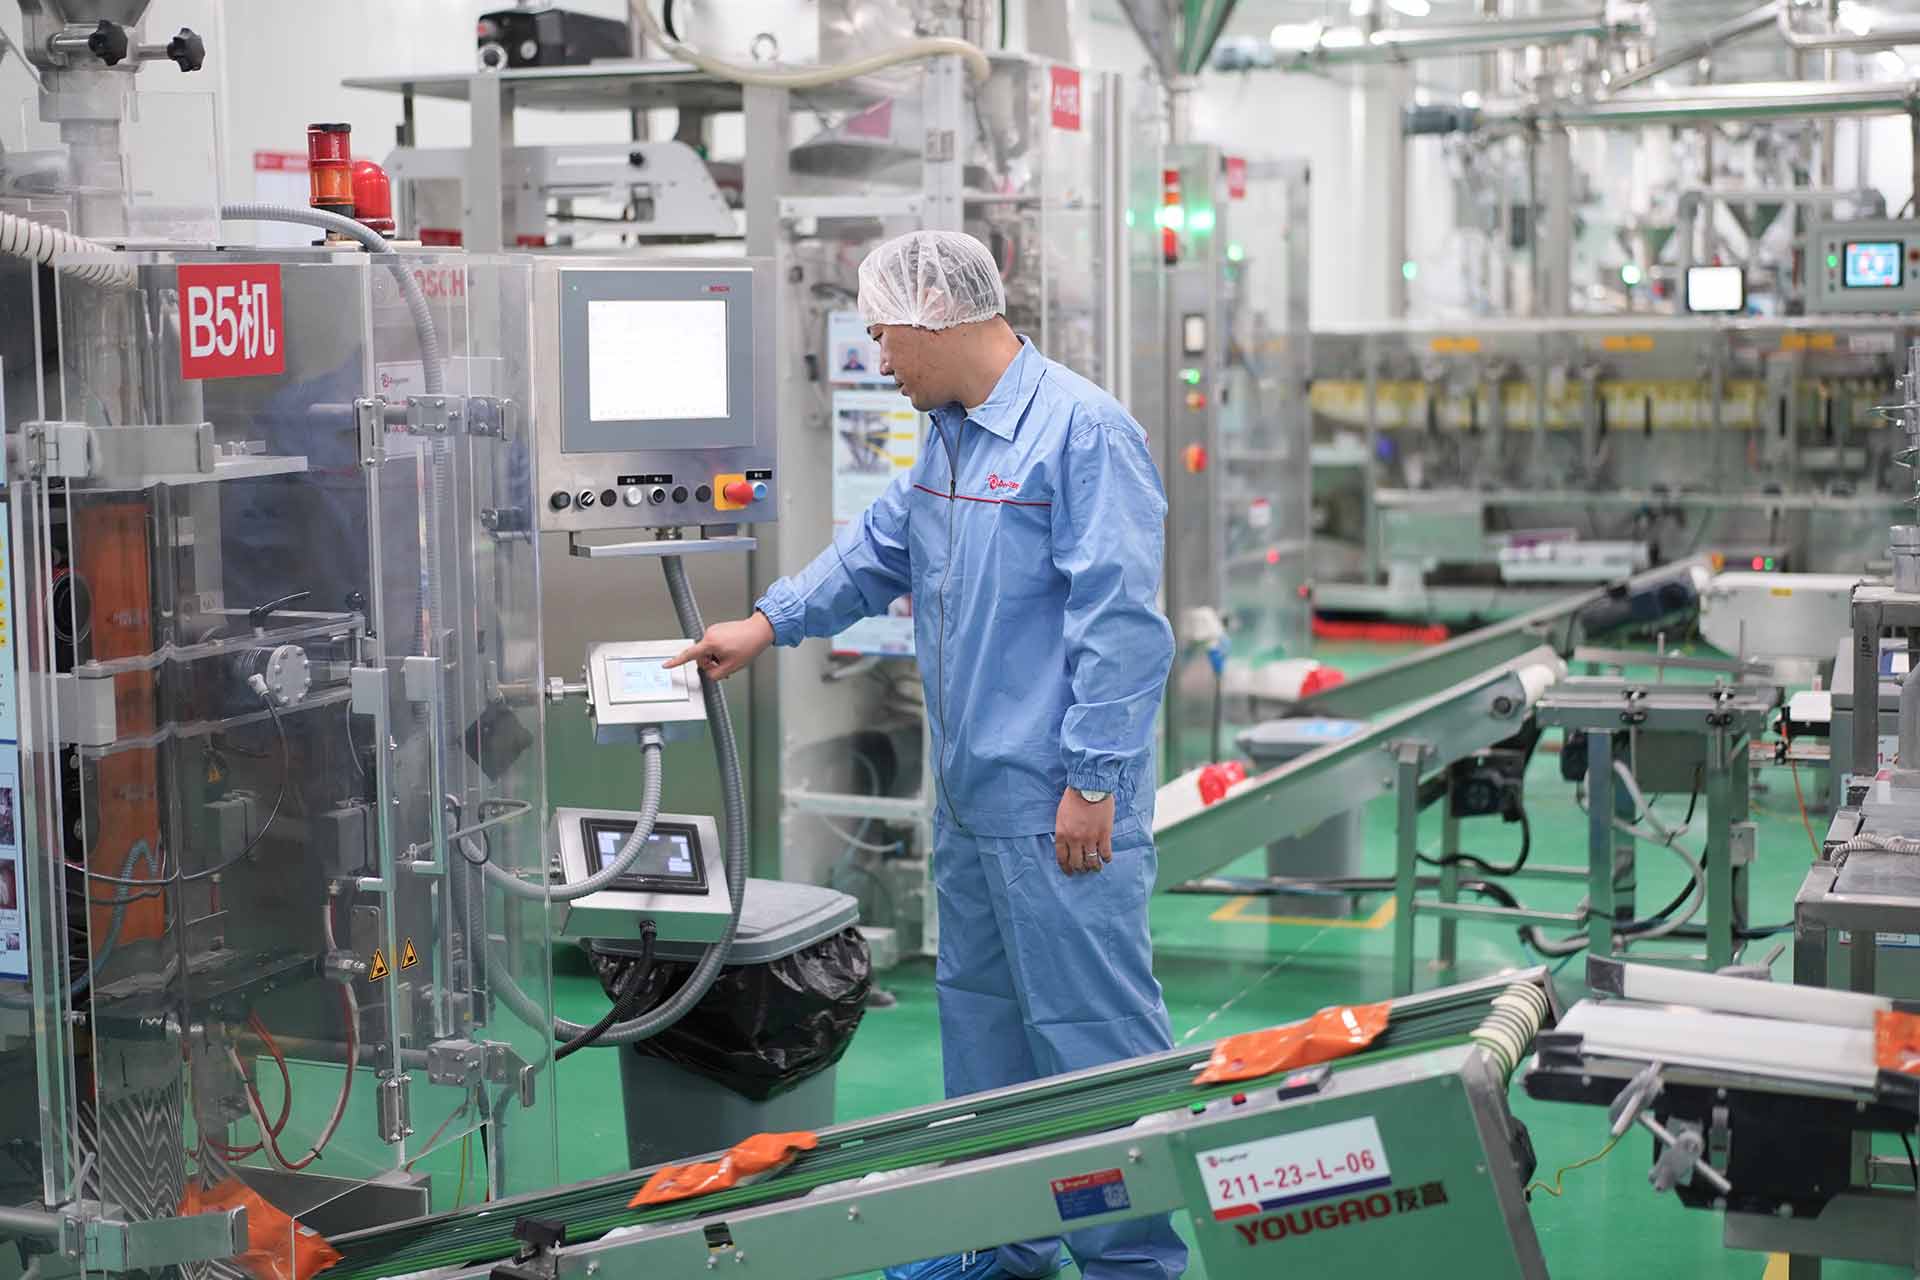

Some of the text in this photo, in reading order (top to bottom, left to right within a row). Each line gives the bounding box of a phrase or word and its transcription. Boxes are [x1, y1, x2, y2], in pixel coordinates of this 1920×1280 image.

[400, 268, 465, 298] OSCH
[188, 279, 275, 359] B5机
[1218, 1149, 1376, 1200] 211-23-L-06
[1234, 1194, 1393, 1247] YOUGAO
